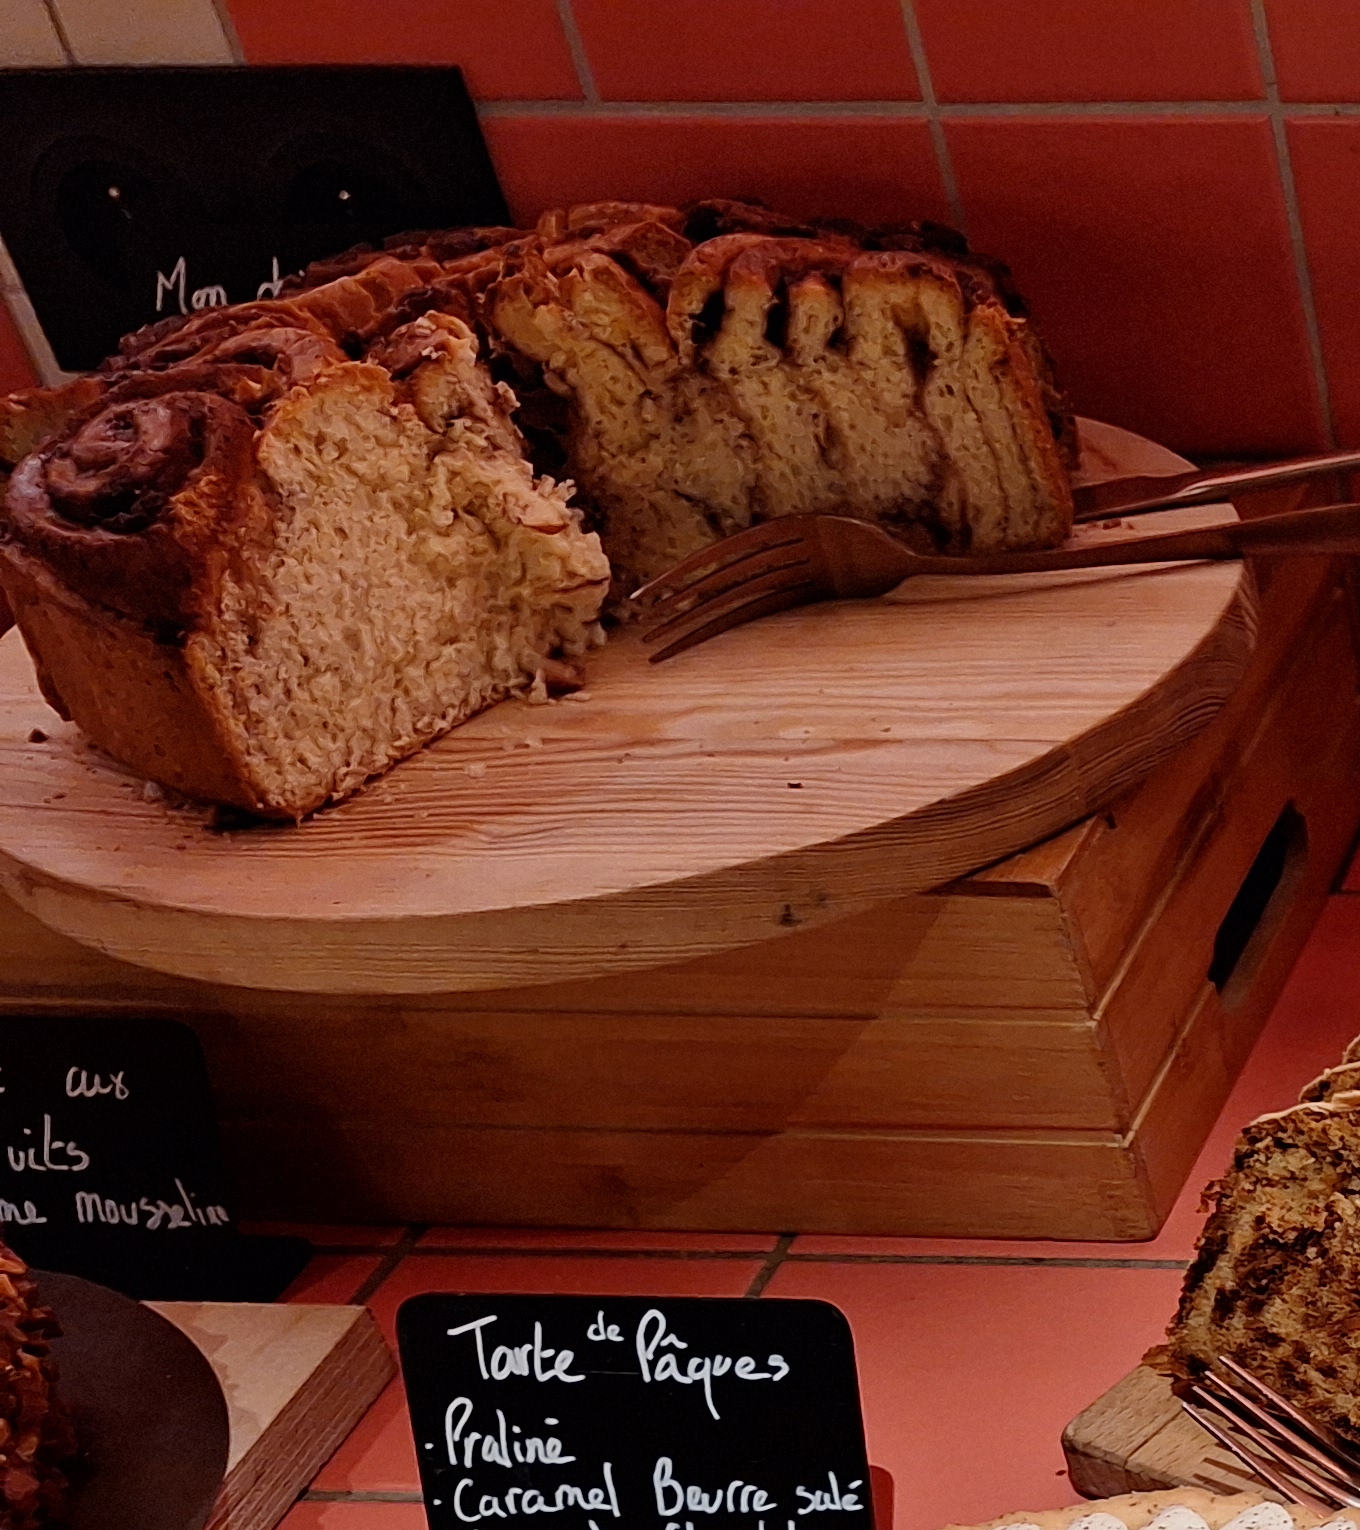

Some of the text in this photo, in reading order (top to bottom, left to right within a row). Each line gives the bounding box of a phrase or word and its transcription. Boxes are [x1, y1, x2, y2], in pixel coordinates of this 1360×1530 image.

[447, 1309, 790, 1420] Tarte de Pâques
[445, 1397, 576, 1468] Praliné
[453, 1456, 865, 1523] Caramel Beurre salé
